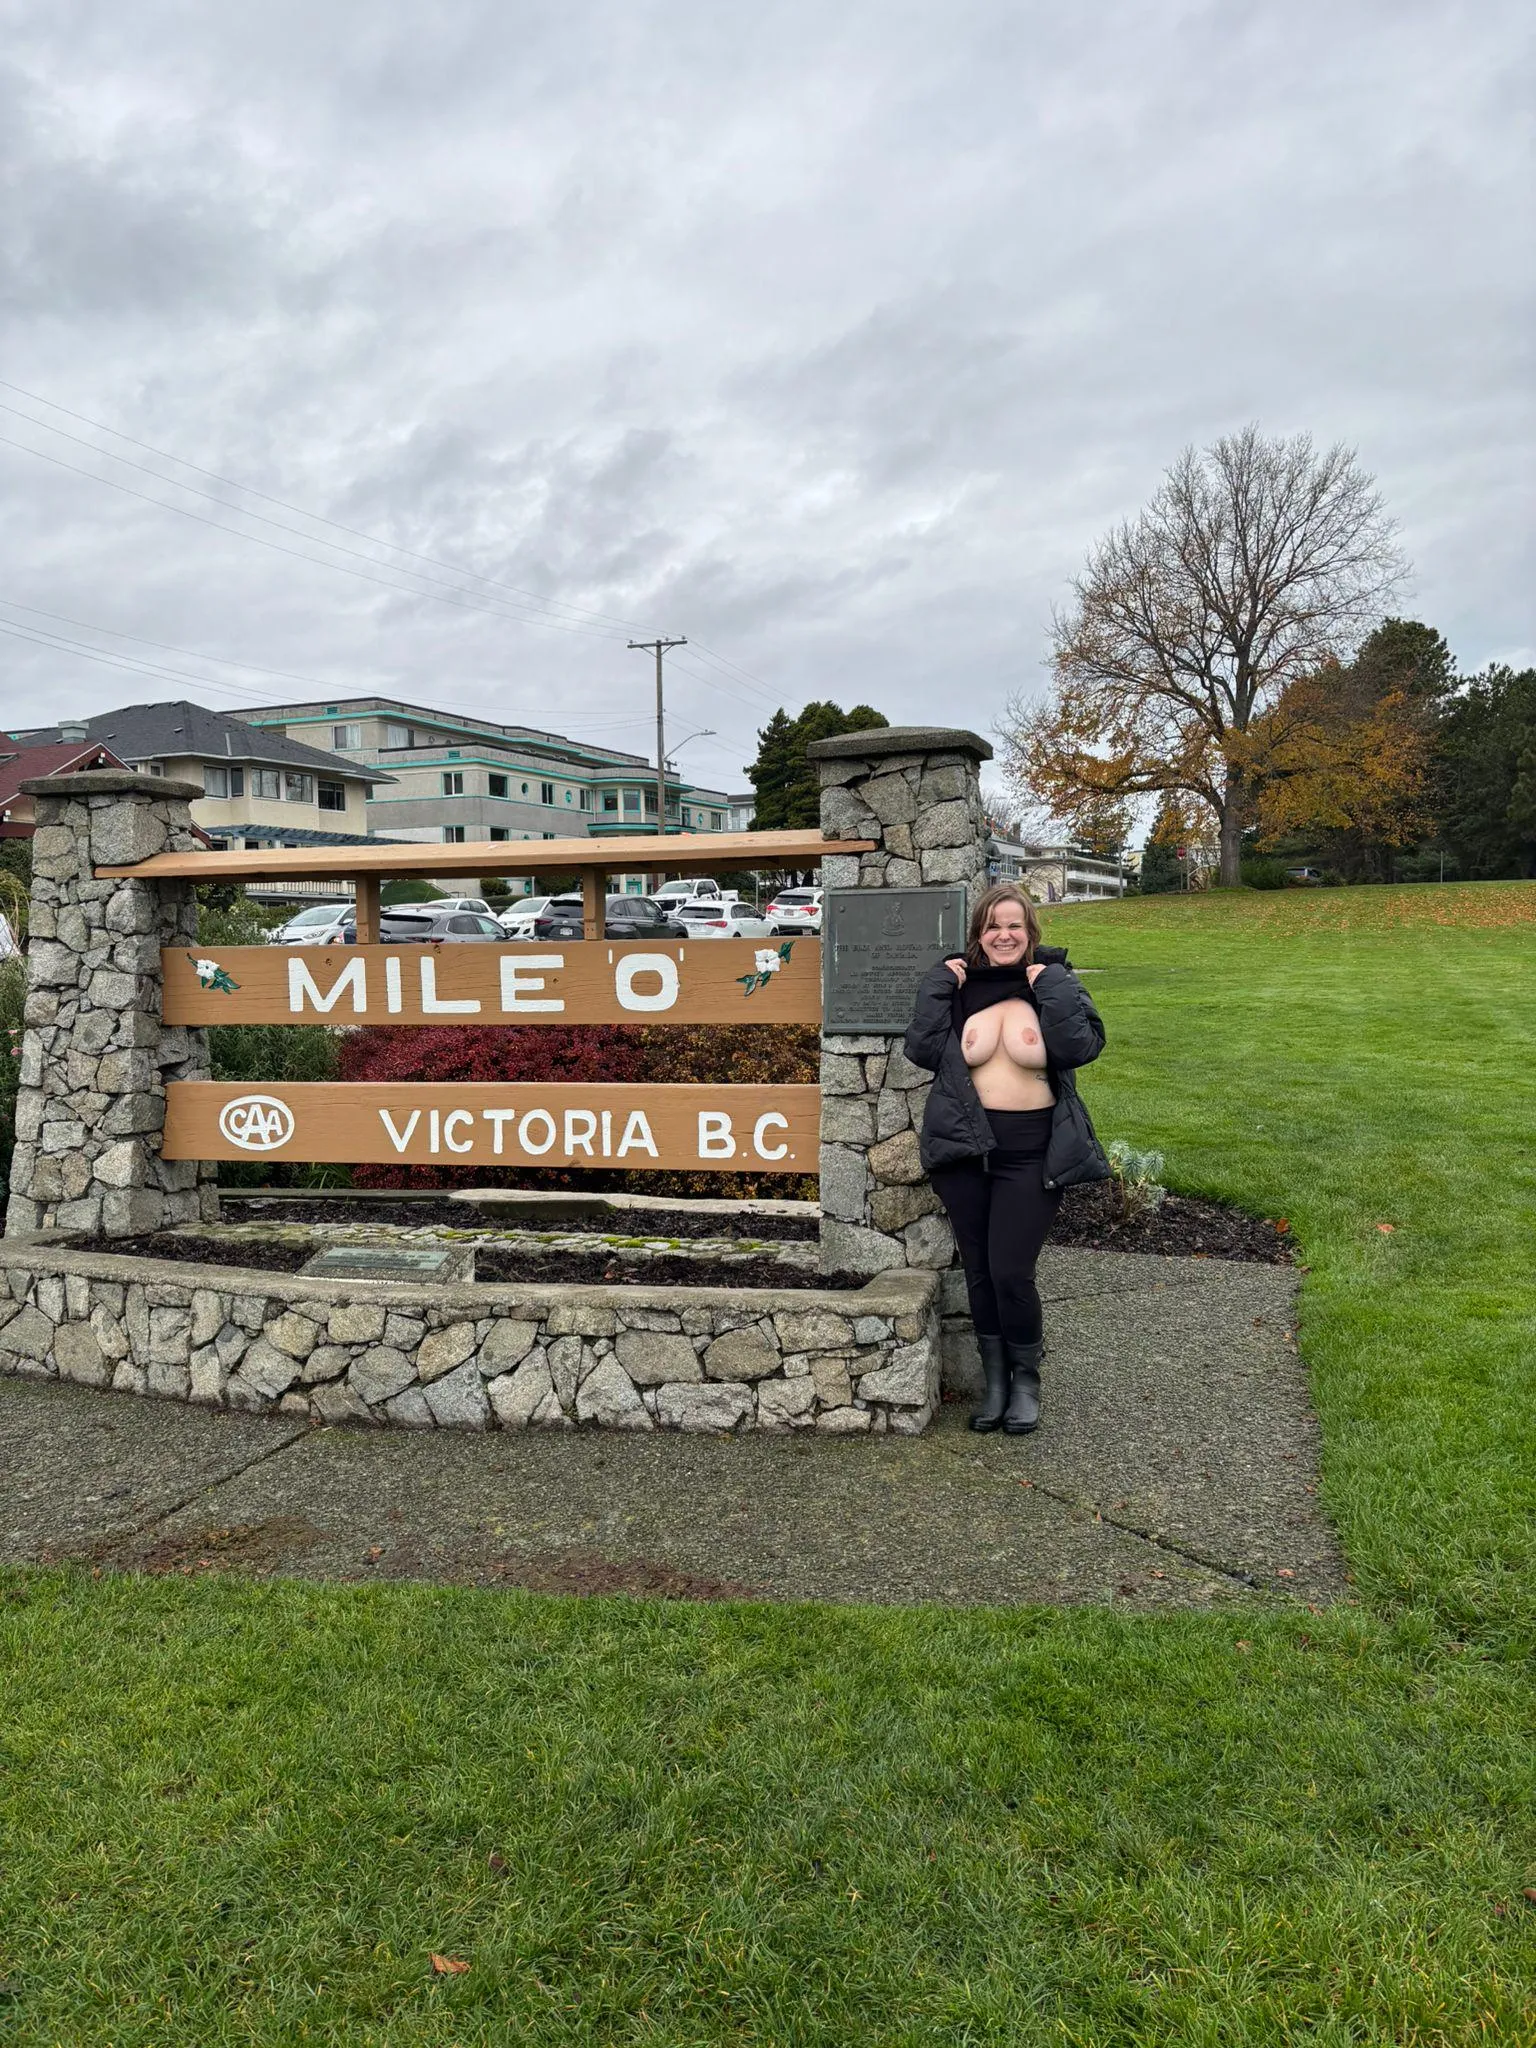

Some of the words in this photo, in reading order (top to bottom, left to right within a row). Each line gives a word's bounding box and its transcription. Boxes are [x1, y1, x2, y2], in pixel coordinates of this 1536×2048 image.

[288, 955, 564, 1013] MILE
[228, 1104, 283, 1144] CAA
[379, 1109, 658, 1157] VICTORIA
[698, 1112, 795, 1160] B.C.
